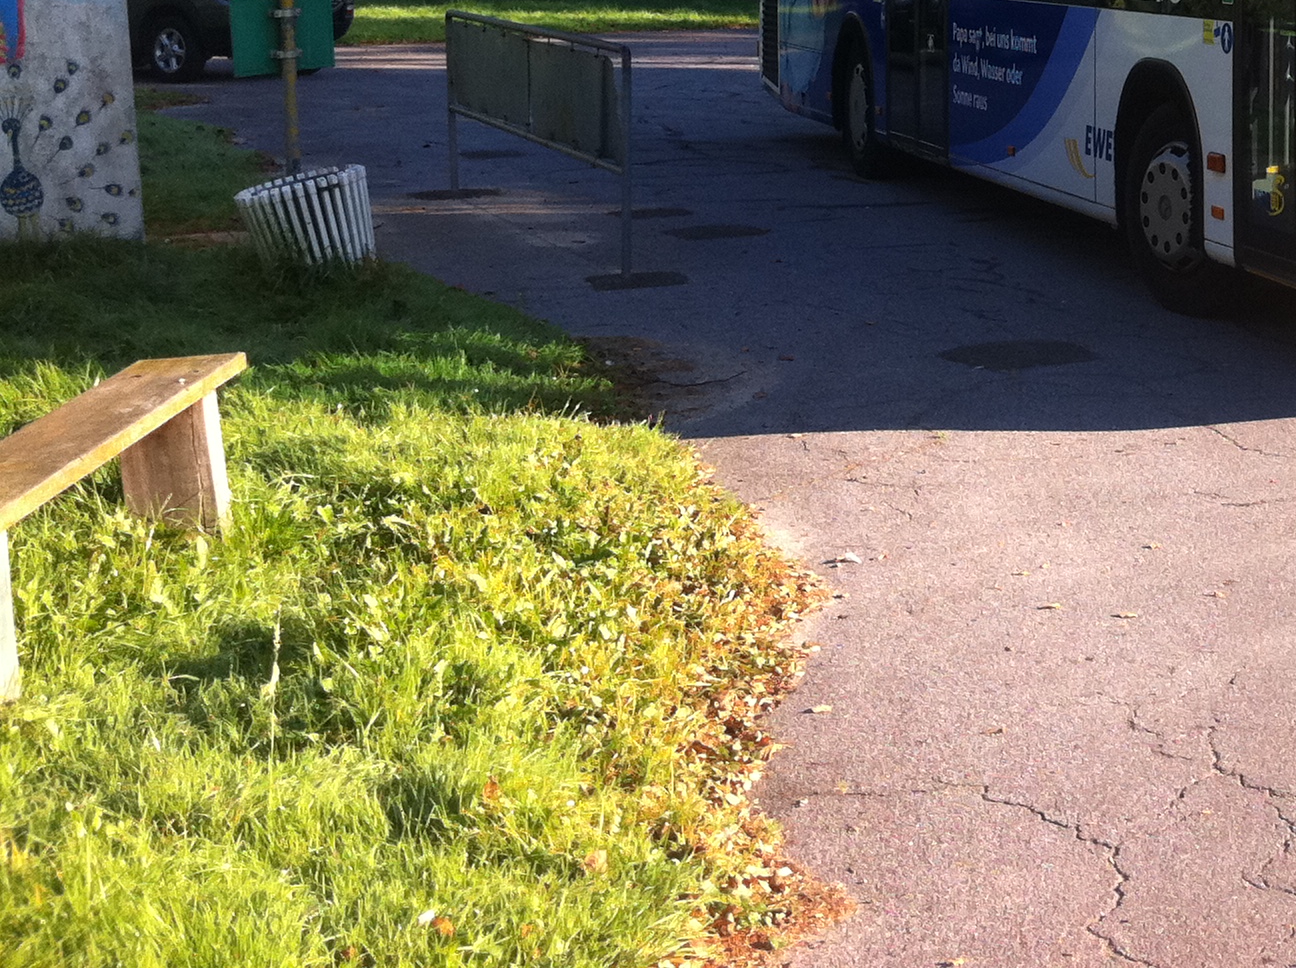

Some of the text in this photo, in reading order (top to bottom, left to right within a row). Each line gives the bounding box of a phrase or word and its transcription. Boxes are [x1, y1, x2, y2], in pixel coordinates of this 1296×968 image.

[953, 22, 968, 48] Papa
[985, 25, 996, 47] bei
[996, 33, 1010, 49] uns
[1010, 28, 1037, 55] kommt
[952, 52, 1024, 86] da Wind, Wasser oder
[953, 84, 988, 112] Sonne raus
[1084, 124, 1114, 162] EWE
